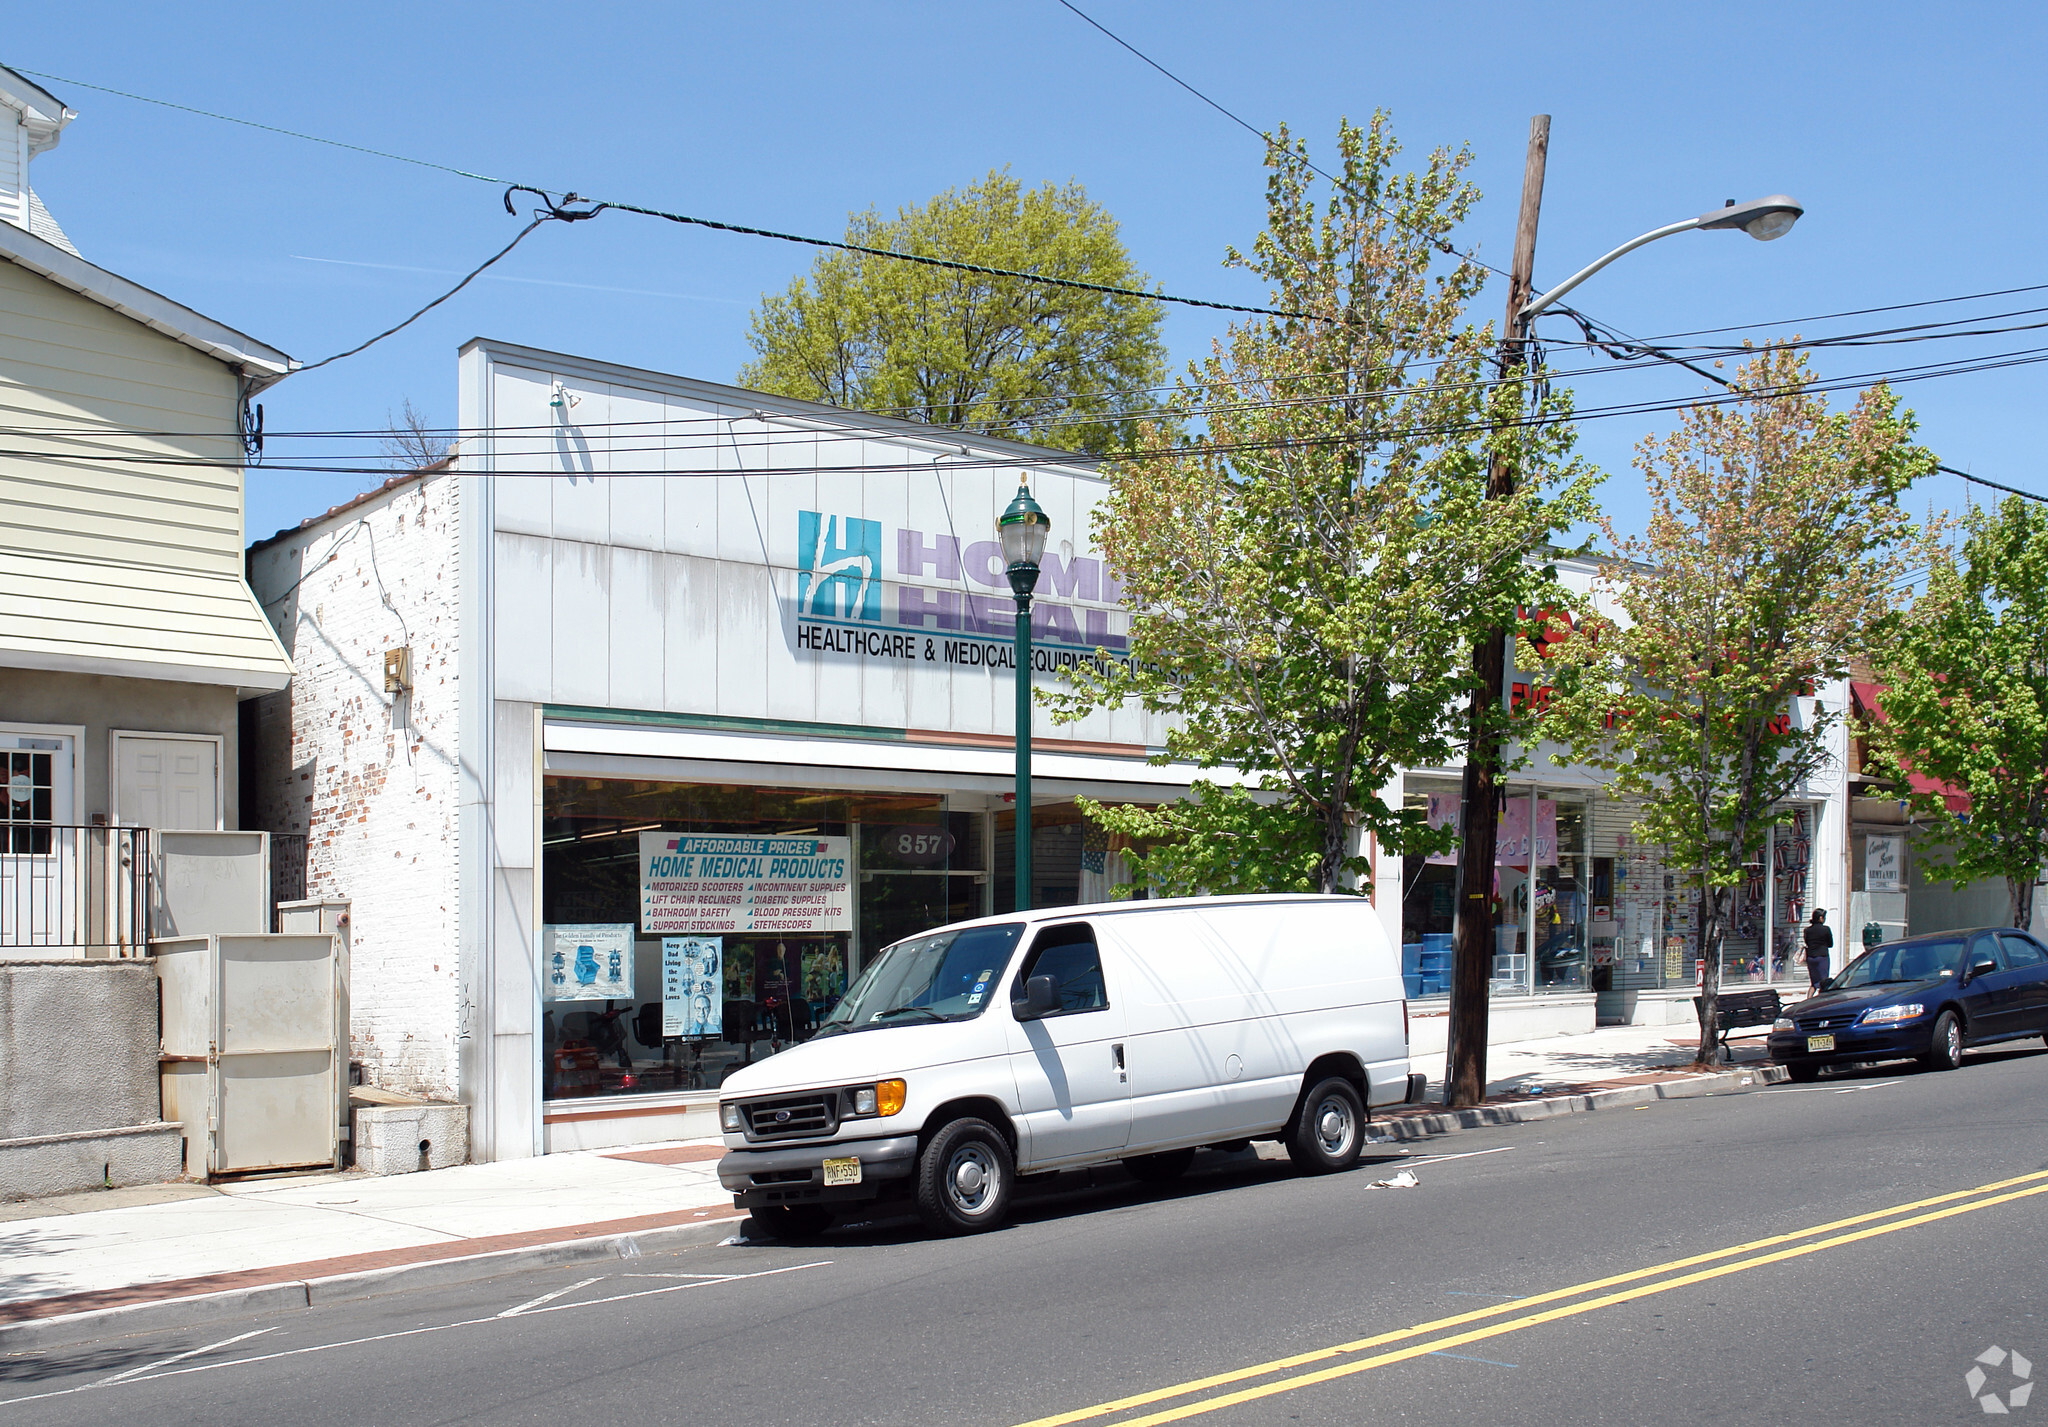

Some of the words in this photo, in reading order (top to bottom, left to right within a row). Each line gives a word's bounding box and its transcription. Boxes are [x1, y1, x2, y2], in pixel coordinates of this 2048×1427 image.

[798, 624, 916, 660] HEALTHCARE
[924, 638, 936, 661] &
[944, 640, 1016, 670] MEDICAL
[683, 839, 765, 854] AFFORDABLE
[768, 841, 812, 854] PRICES
[898, 834, 941, 854] 857
[649, 856, 694, 877] HOME
[699, 857, 763, 878] MEDICAL
[769, 858, 845, 879] PRODUCTS
[651, 882, 699, 891] MOTORIZED
[701, 882, 744, 891] SCOOTERS
[754, 883, 807, 892] INCONTINENT
[809, 883, 846, 892] SUPPLIES
[651, 895, 668, 904] LIFT
[670, 895, 695, 904] CHAIR
[697, 895, 742, 904] RECLINERS
[754, 895, 789, 904] DIABETIC
[791, 895, 827, 904] SUPPLIES
[652, 908, 698, 917] BATHROOM
[700, 908, 731, 917] SAFETY
[753, 907, 780, 916] BLOOD
[782, 907, 822, 916] PRESSURE
[824, 907, 842, 916] KITS
[652, 921, 689, 930] SUPPORT
[691, 920, 736, 930] STOCKINGS
[753, 920, 812, 929] STETHESCOPES
